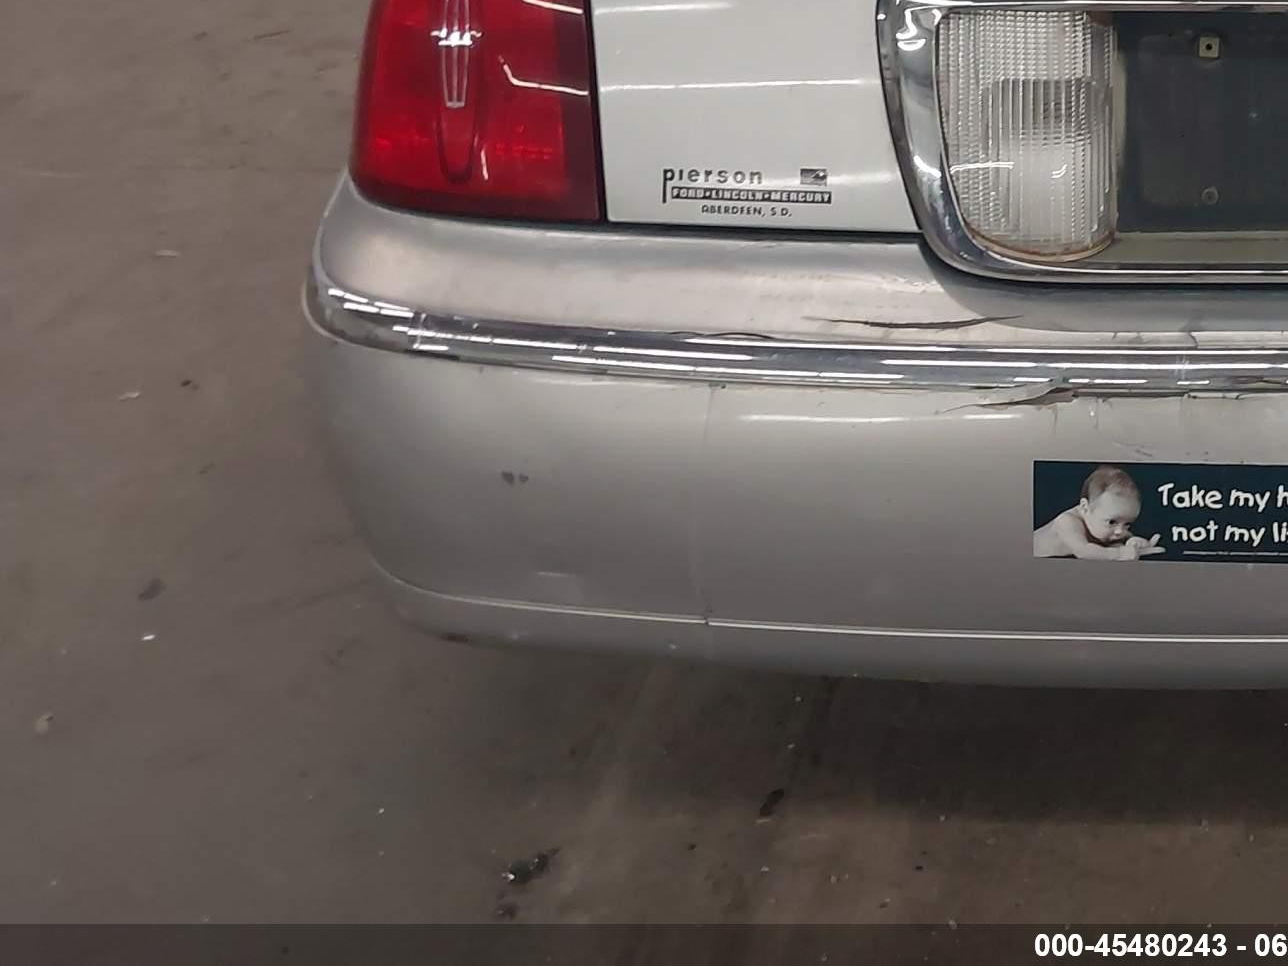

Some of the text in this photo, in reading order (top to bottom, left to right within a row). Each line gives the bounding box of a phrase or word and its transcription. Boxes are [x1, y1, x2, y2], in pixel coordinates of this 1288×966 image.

[663, 168, 763, 204] pierson
[1158, 483, 1223, 509] Take
[1229, 491, 1271, 513] my
[1171, 520, 1219, 543] not
[1224, 526, 1266, 547] my
